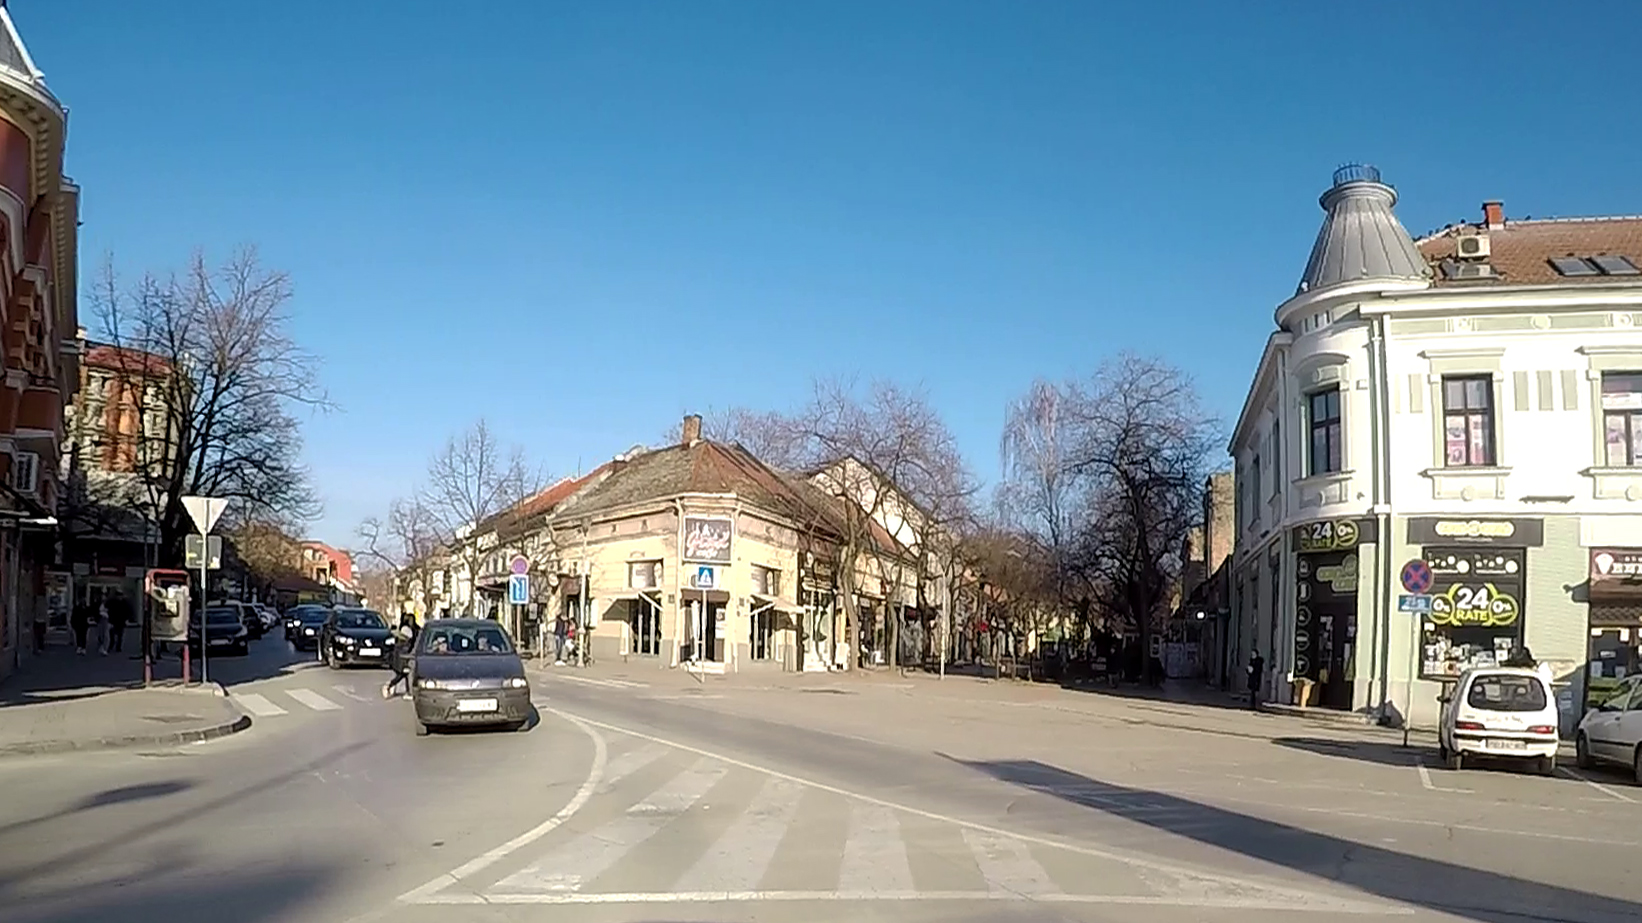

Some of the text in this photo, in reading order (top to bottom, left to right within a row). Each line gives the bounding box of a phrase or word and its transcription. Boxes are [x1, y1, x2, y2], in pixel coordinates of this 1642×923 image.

[1313, 522, 1332, 539] 24
[1456, 587, 1489, 610] 24
[1456, 610, 1488, 621] RATE
